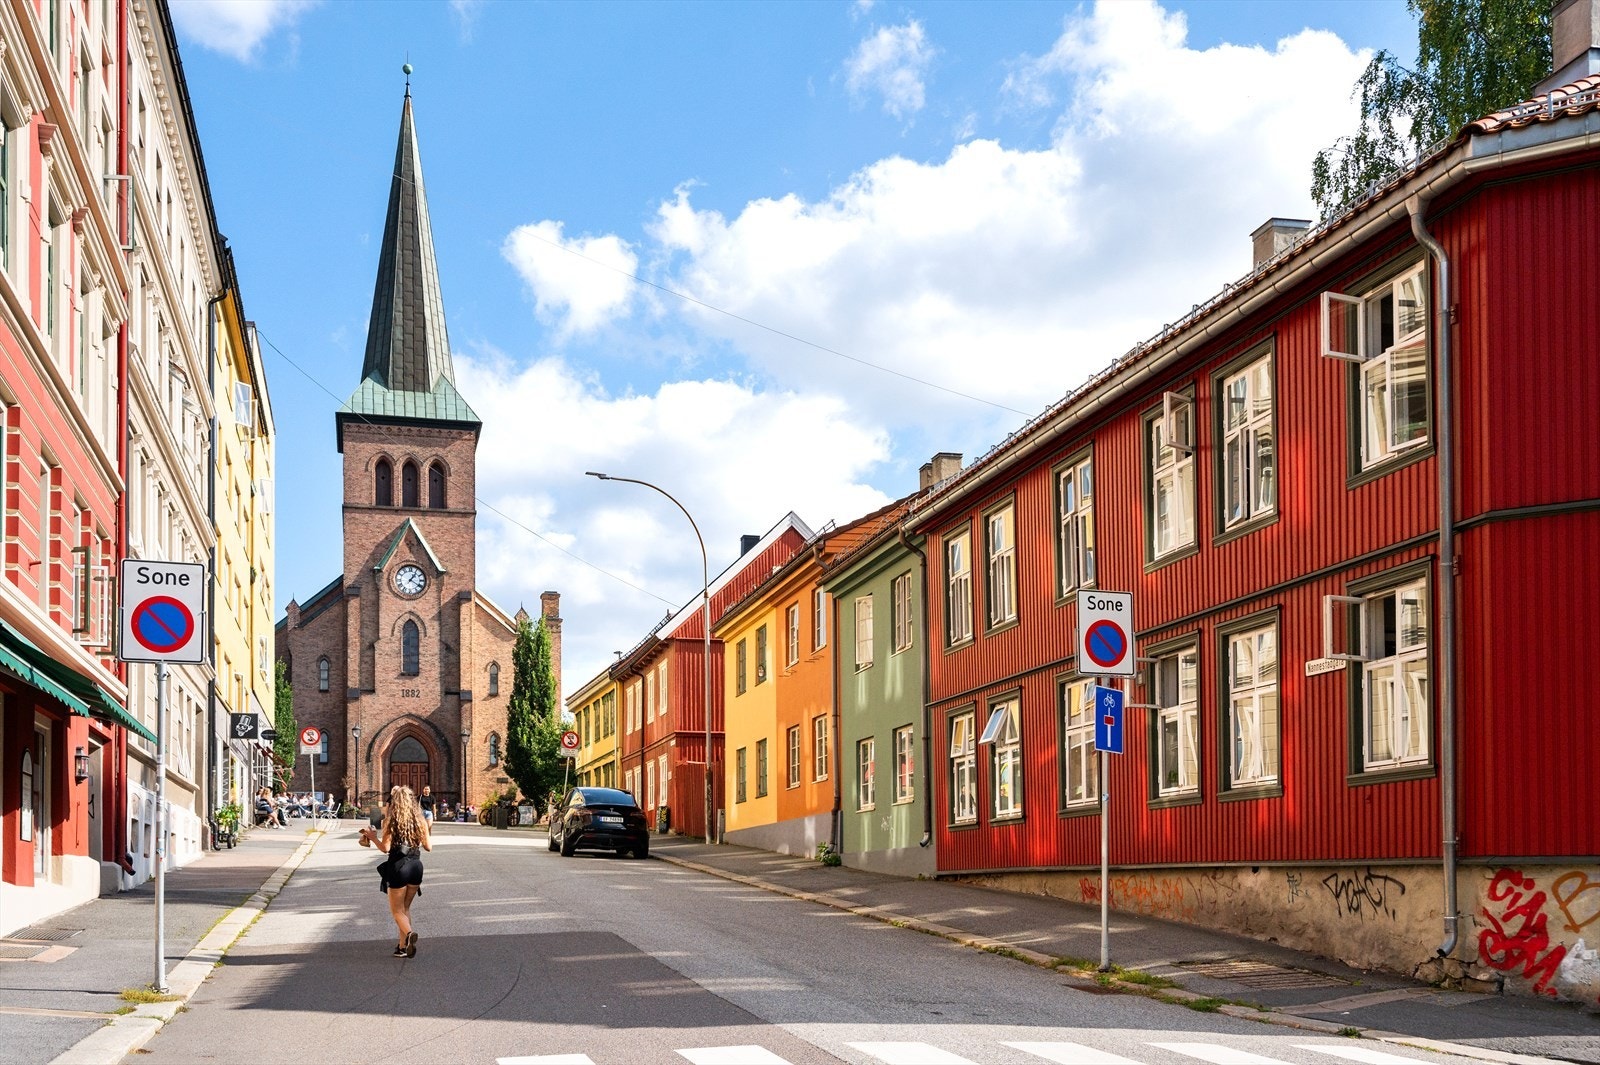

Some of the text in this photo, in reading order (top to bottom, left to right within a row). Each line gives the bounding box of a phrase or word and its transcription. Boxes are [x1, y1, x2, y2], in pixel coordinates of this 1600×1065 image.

[136, 566, 190, 586] Sone
[1087, 595, 1123, 612] Sone
[401, 689, 421, 698] 1882
